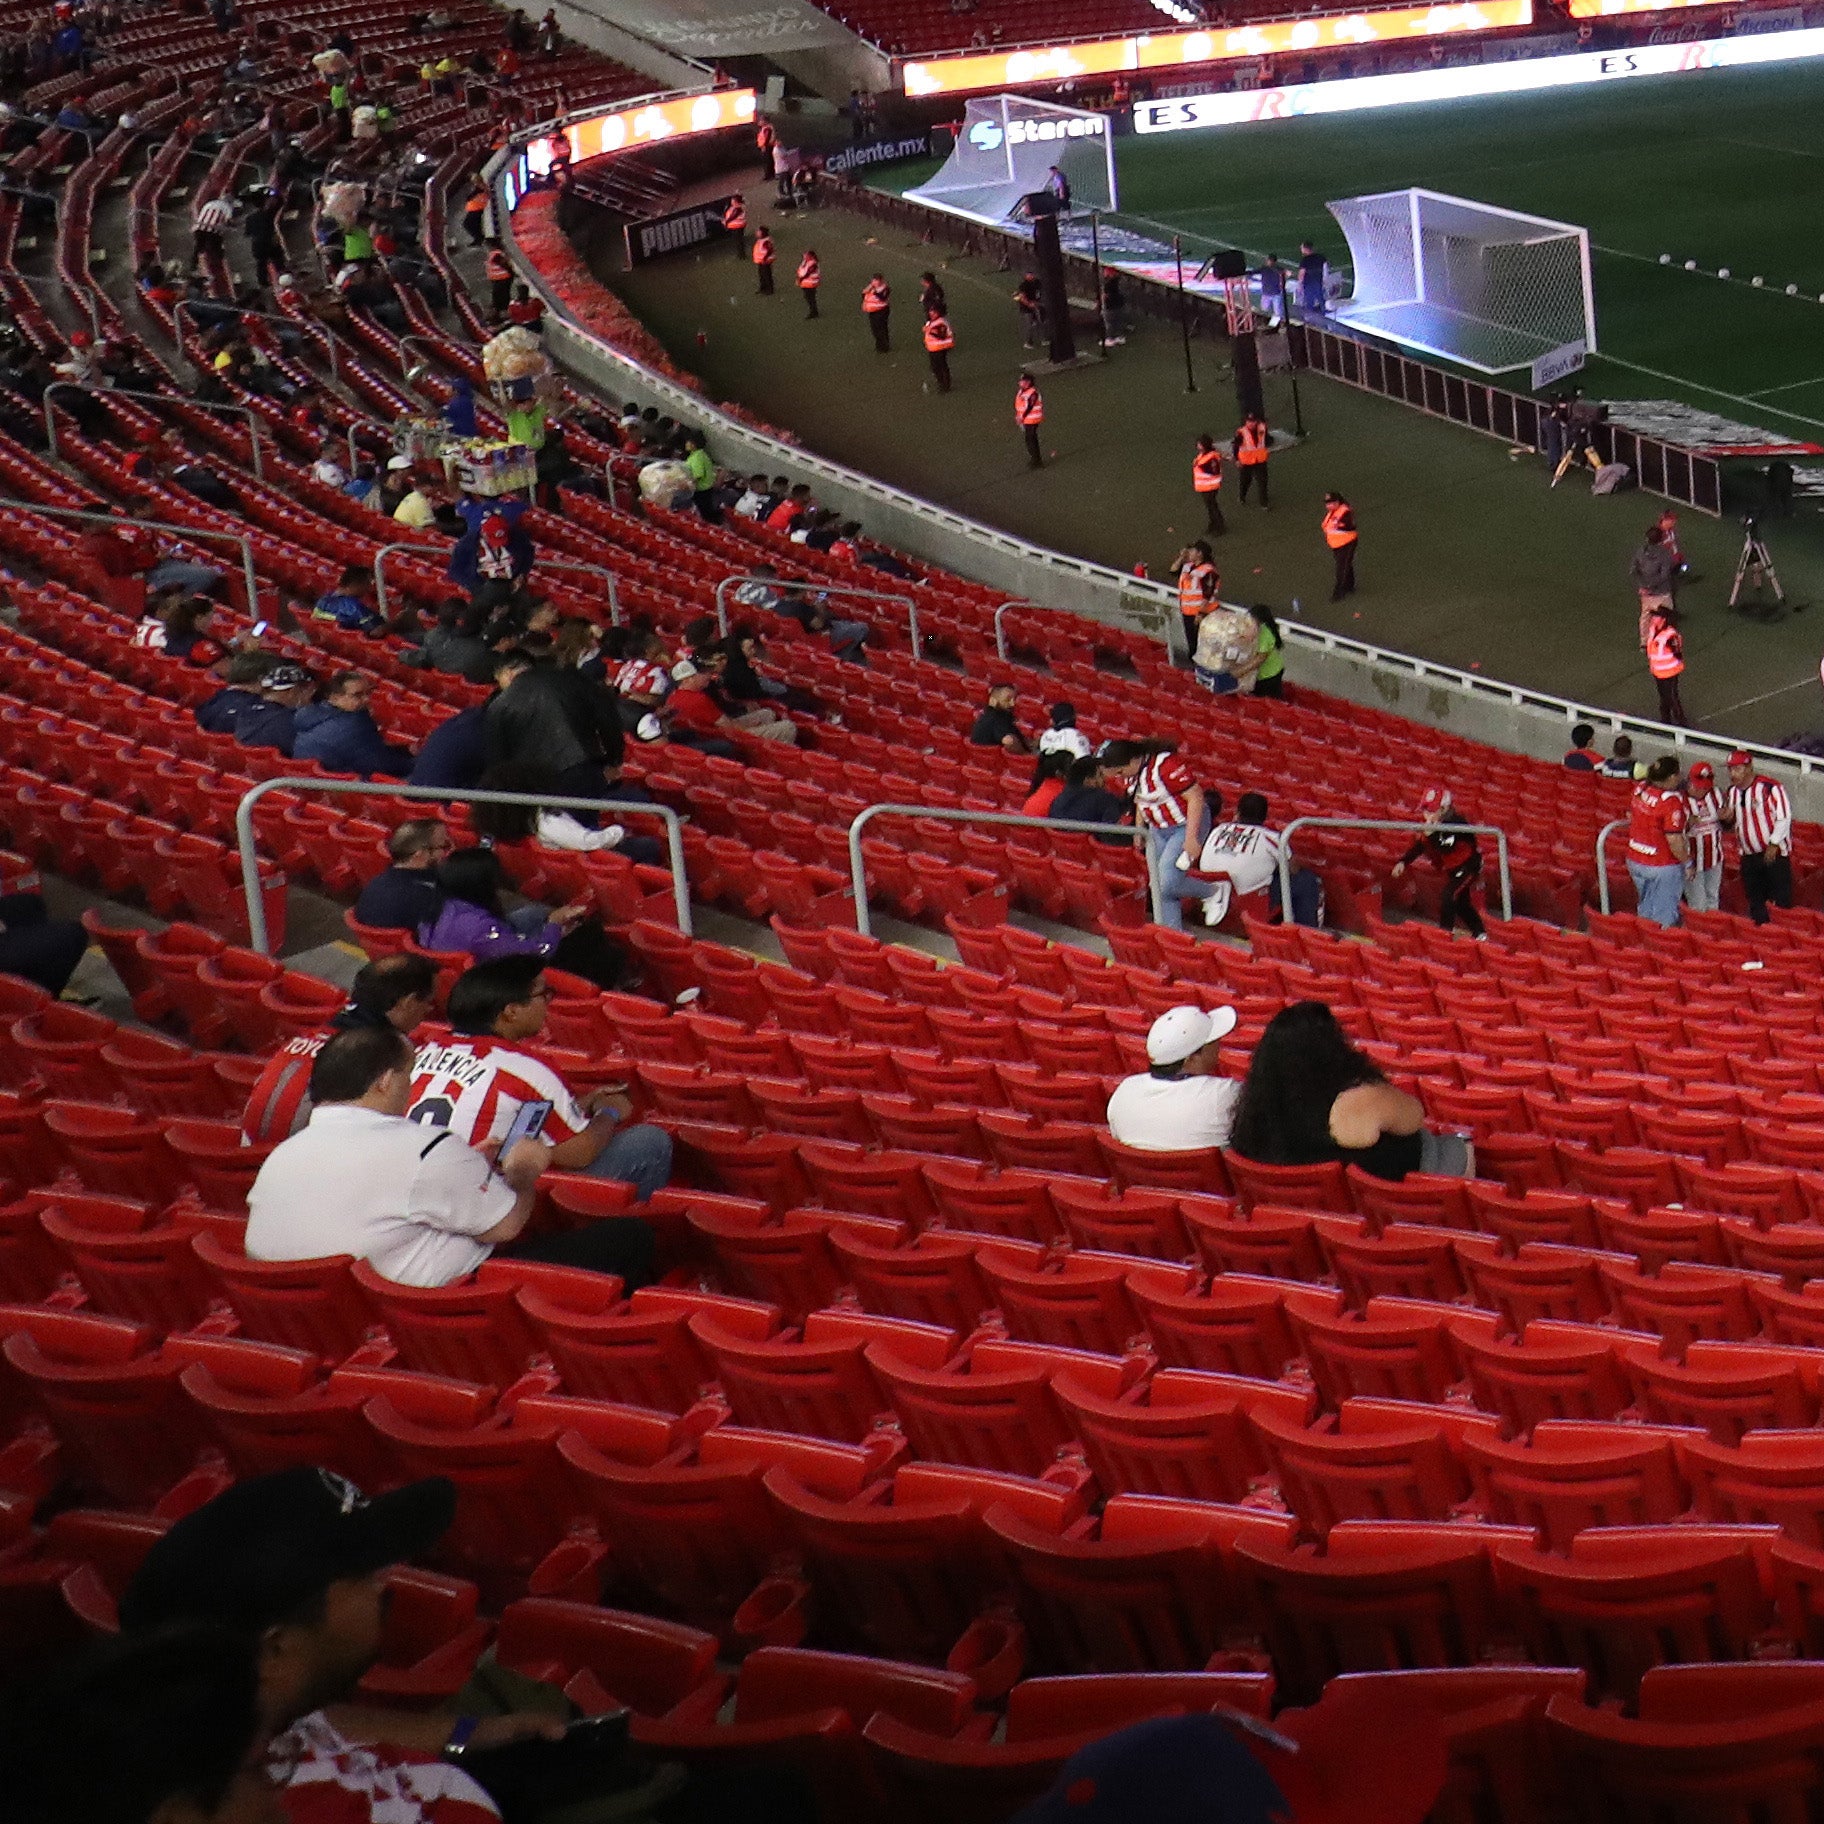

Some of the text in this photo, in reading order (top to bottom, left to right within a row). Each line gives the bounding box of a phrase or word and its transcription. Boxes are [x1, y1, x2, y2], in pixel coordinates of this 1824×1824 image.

[1006, 117, 1104, 144] Steren
[827, 138, 927, 173] caliente.mx
[642, 212, 708, 258] PUMA
